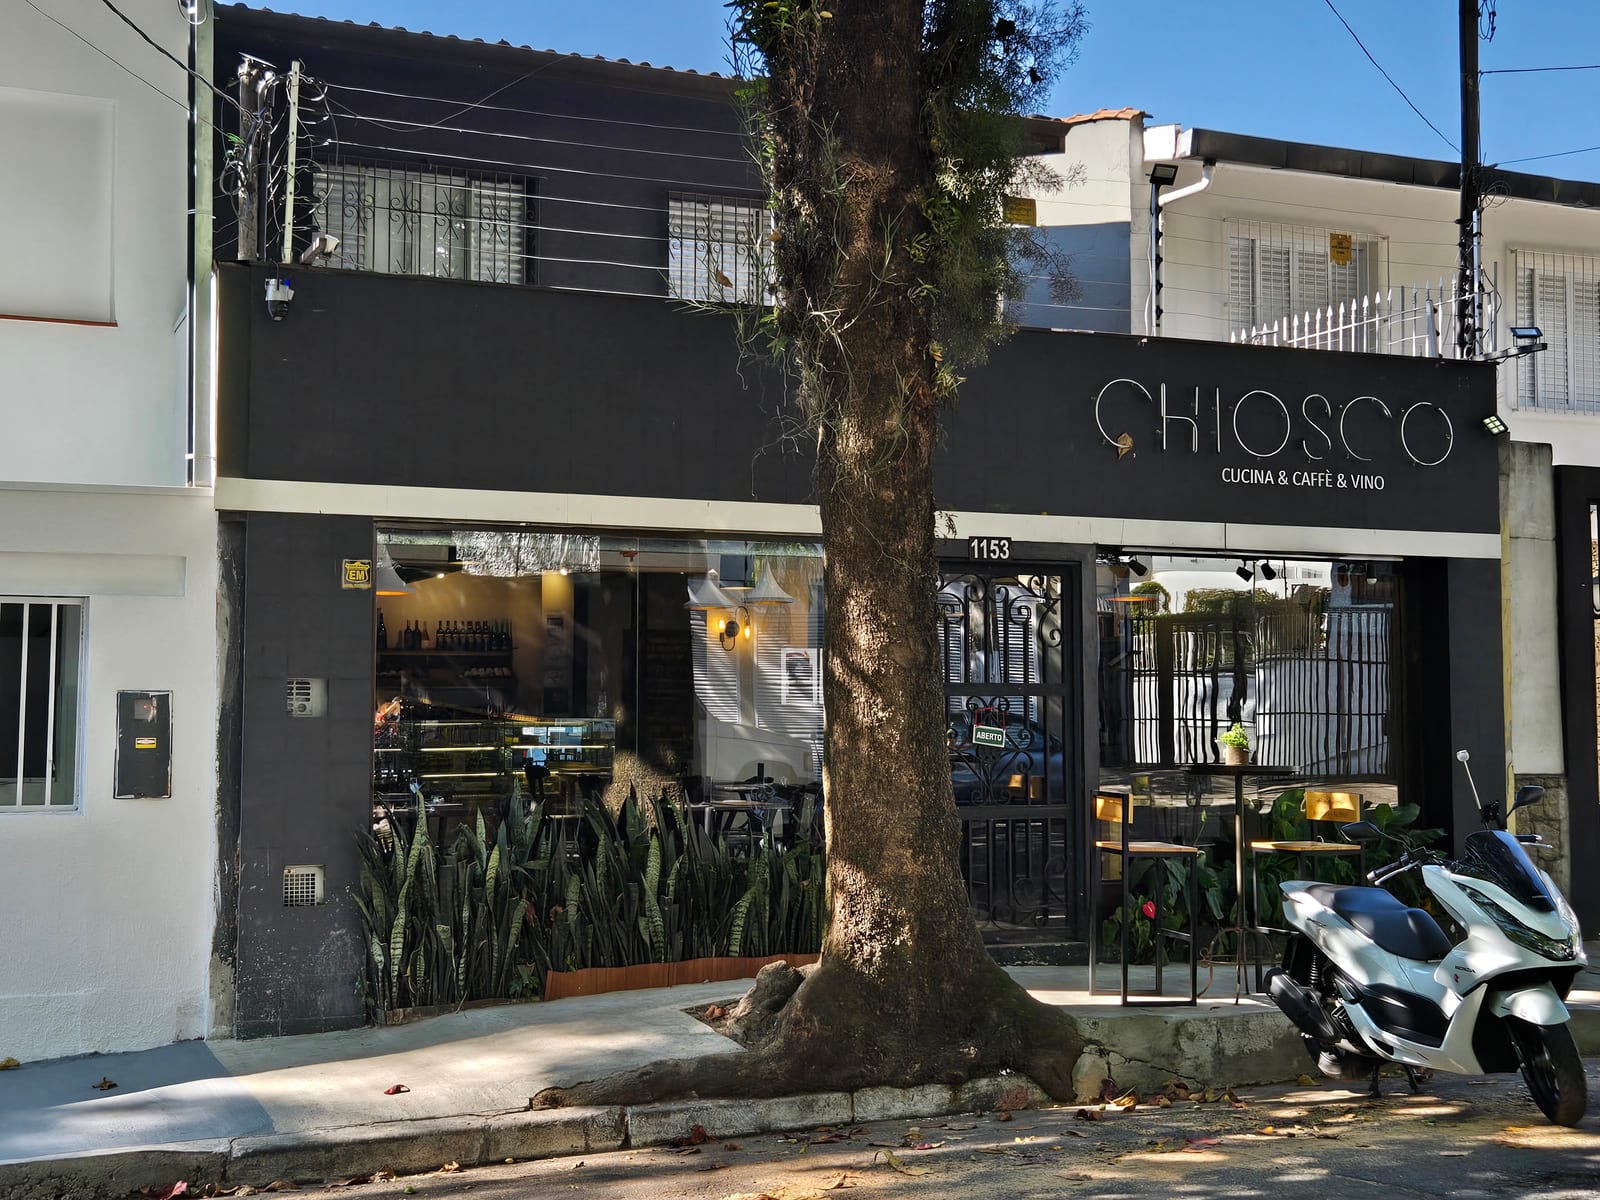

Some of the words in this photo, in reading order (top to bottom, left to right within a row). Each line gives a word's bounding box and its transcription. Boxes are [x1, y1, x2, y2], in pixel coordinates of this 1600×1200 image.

[1095, 378, 1453, 466] CHIOSCO
[1221, 467, 1274, 485] CUCINA
[1278, 470, 1289, 485] &
[1292, 469, 1333, 488] CAFFÈ
[1336, 473, 1348, 489] &
[1350, 474, 1385, 490] VINO
[971, 539, 1009, 559] 1153
[976, 731, 1002, 742] ABERTO
